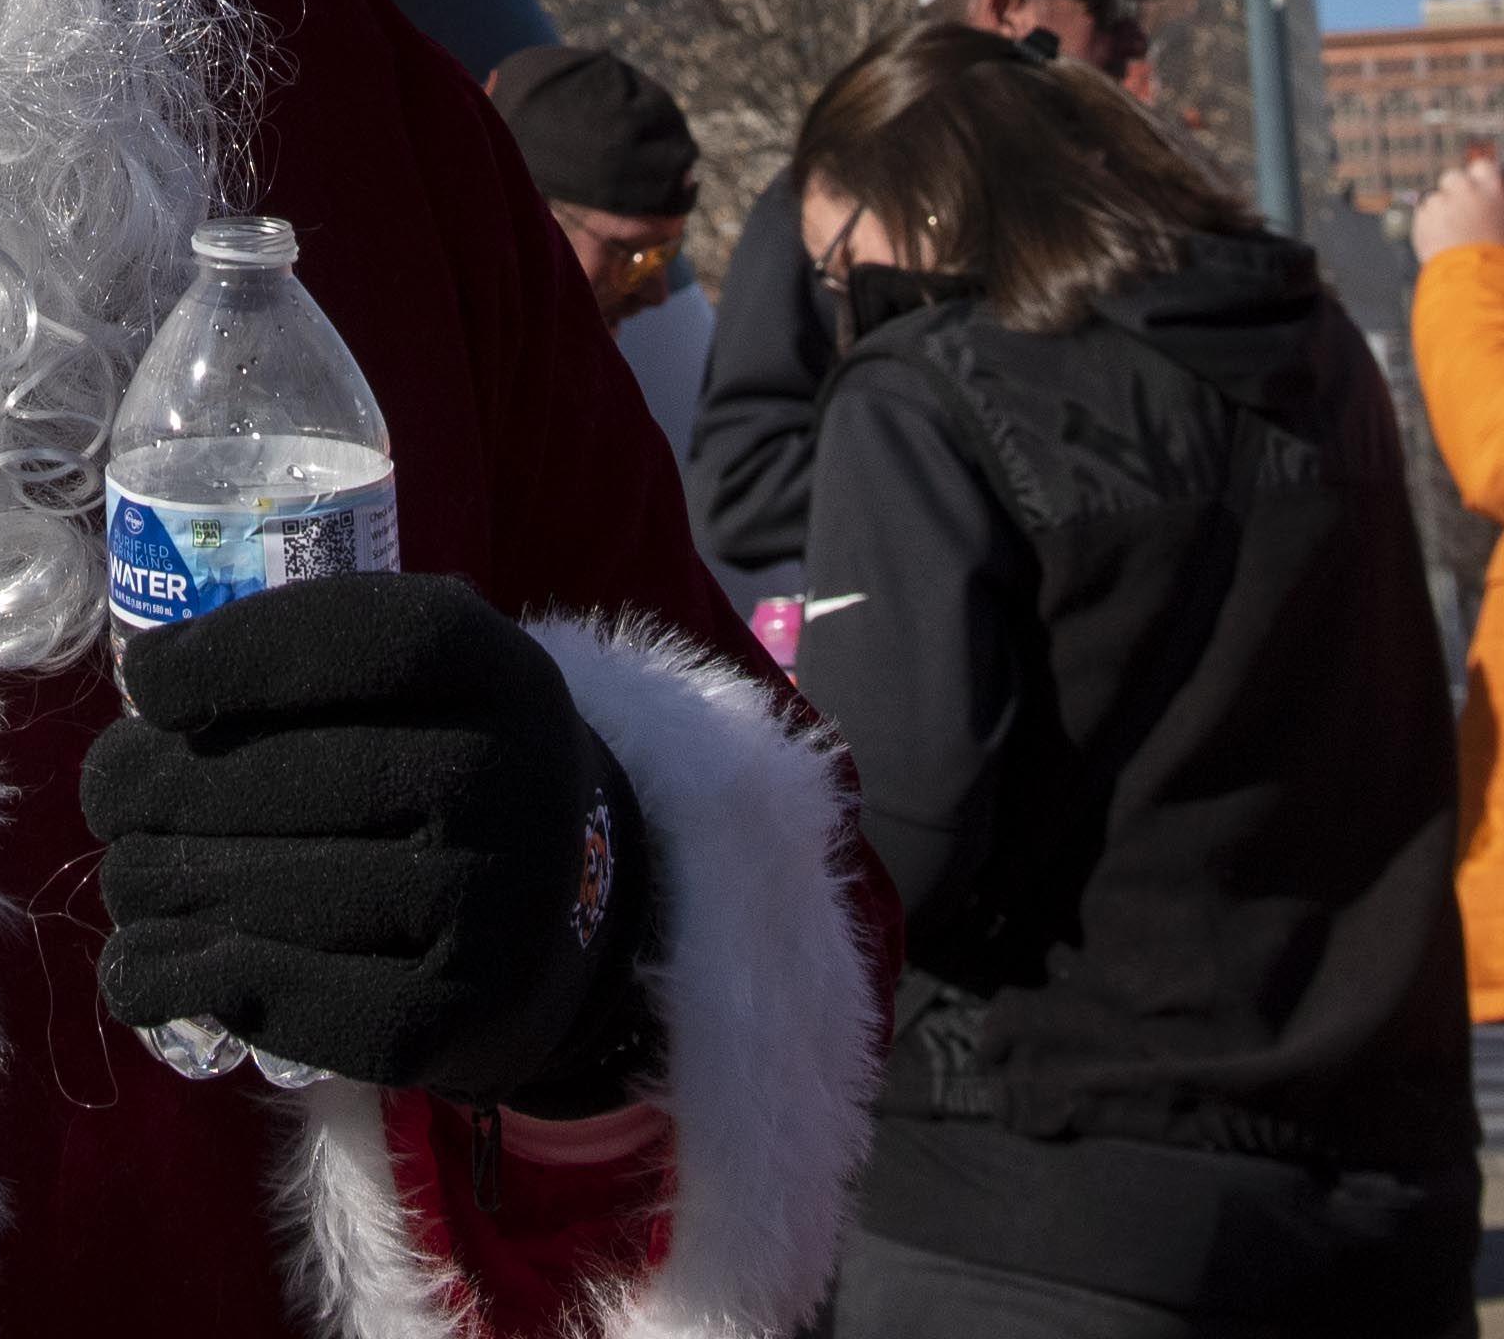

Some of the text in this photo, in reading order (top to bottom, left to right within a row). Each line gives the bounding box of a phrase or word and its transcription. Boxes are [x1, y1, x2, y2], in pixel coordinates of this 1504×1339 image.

[112, 542, 173, 571] DRINKING
[114, 529, 169, 558] PURIFIED
[110, 551, 187, 602] WATER
